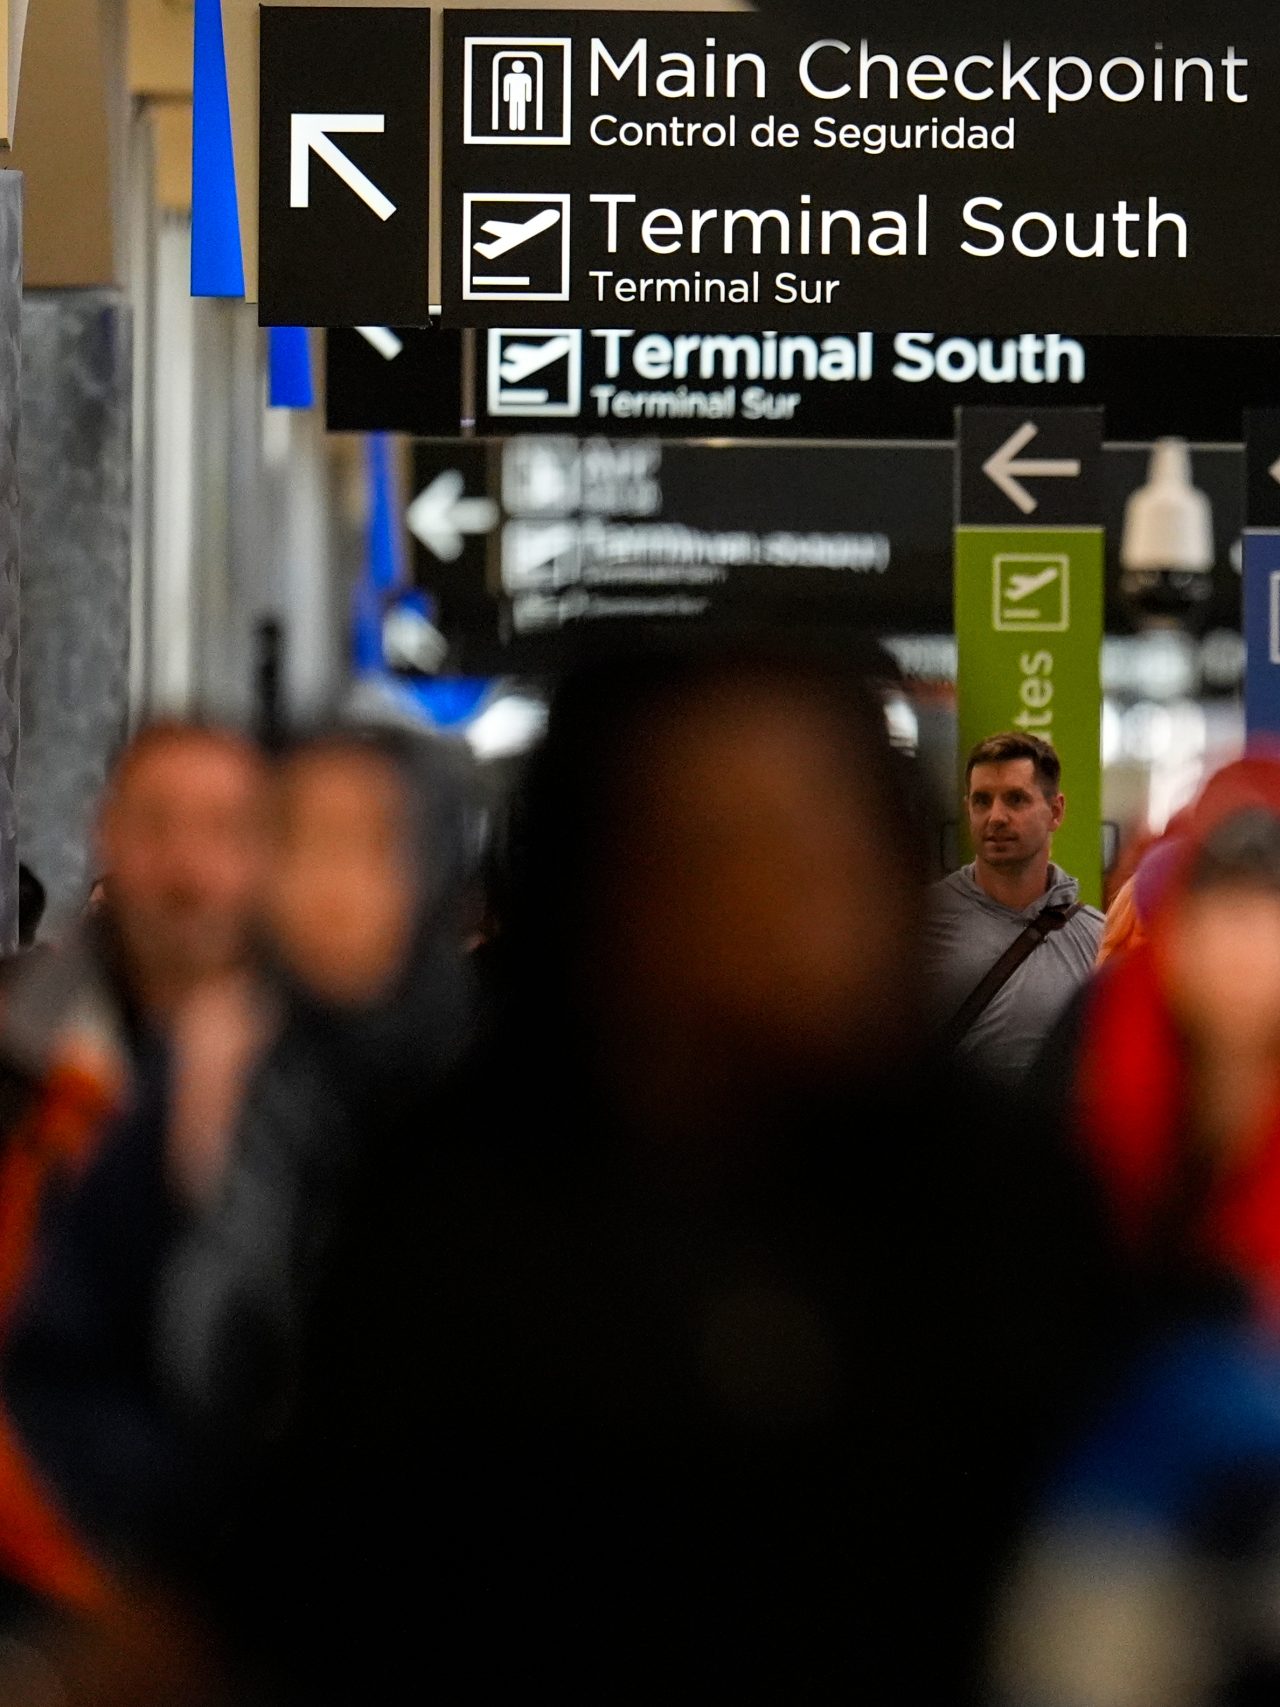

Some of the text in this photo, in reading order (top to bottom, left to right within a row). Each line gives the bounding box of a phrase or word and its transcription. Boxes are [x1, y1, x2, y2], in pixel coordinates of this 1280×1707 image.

[589, 37, 1249, 114] Main Checkpoint
[589, 114, 1015, 155] Control de Seguridad
[589, 193, 1187, 259] Terminal South
[588, 270, 840, 304] Terminal Sur
[591, 329, 1085, 384] Terminal South
[590, 384, 801, 420] Terminal Sur
[1013, 650, 1053, 746] tes
